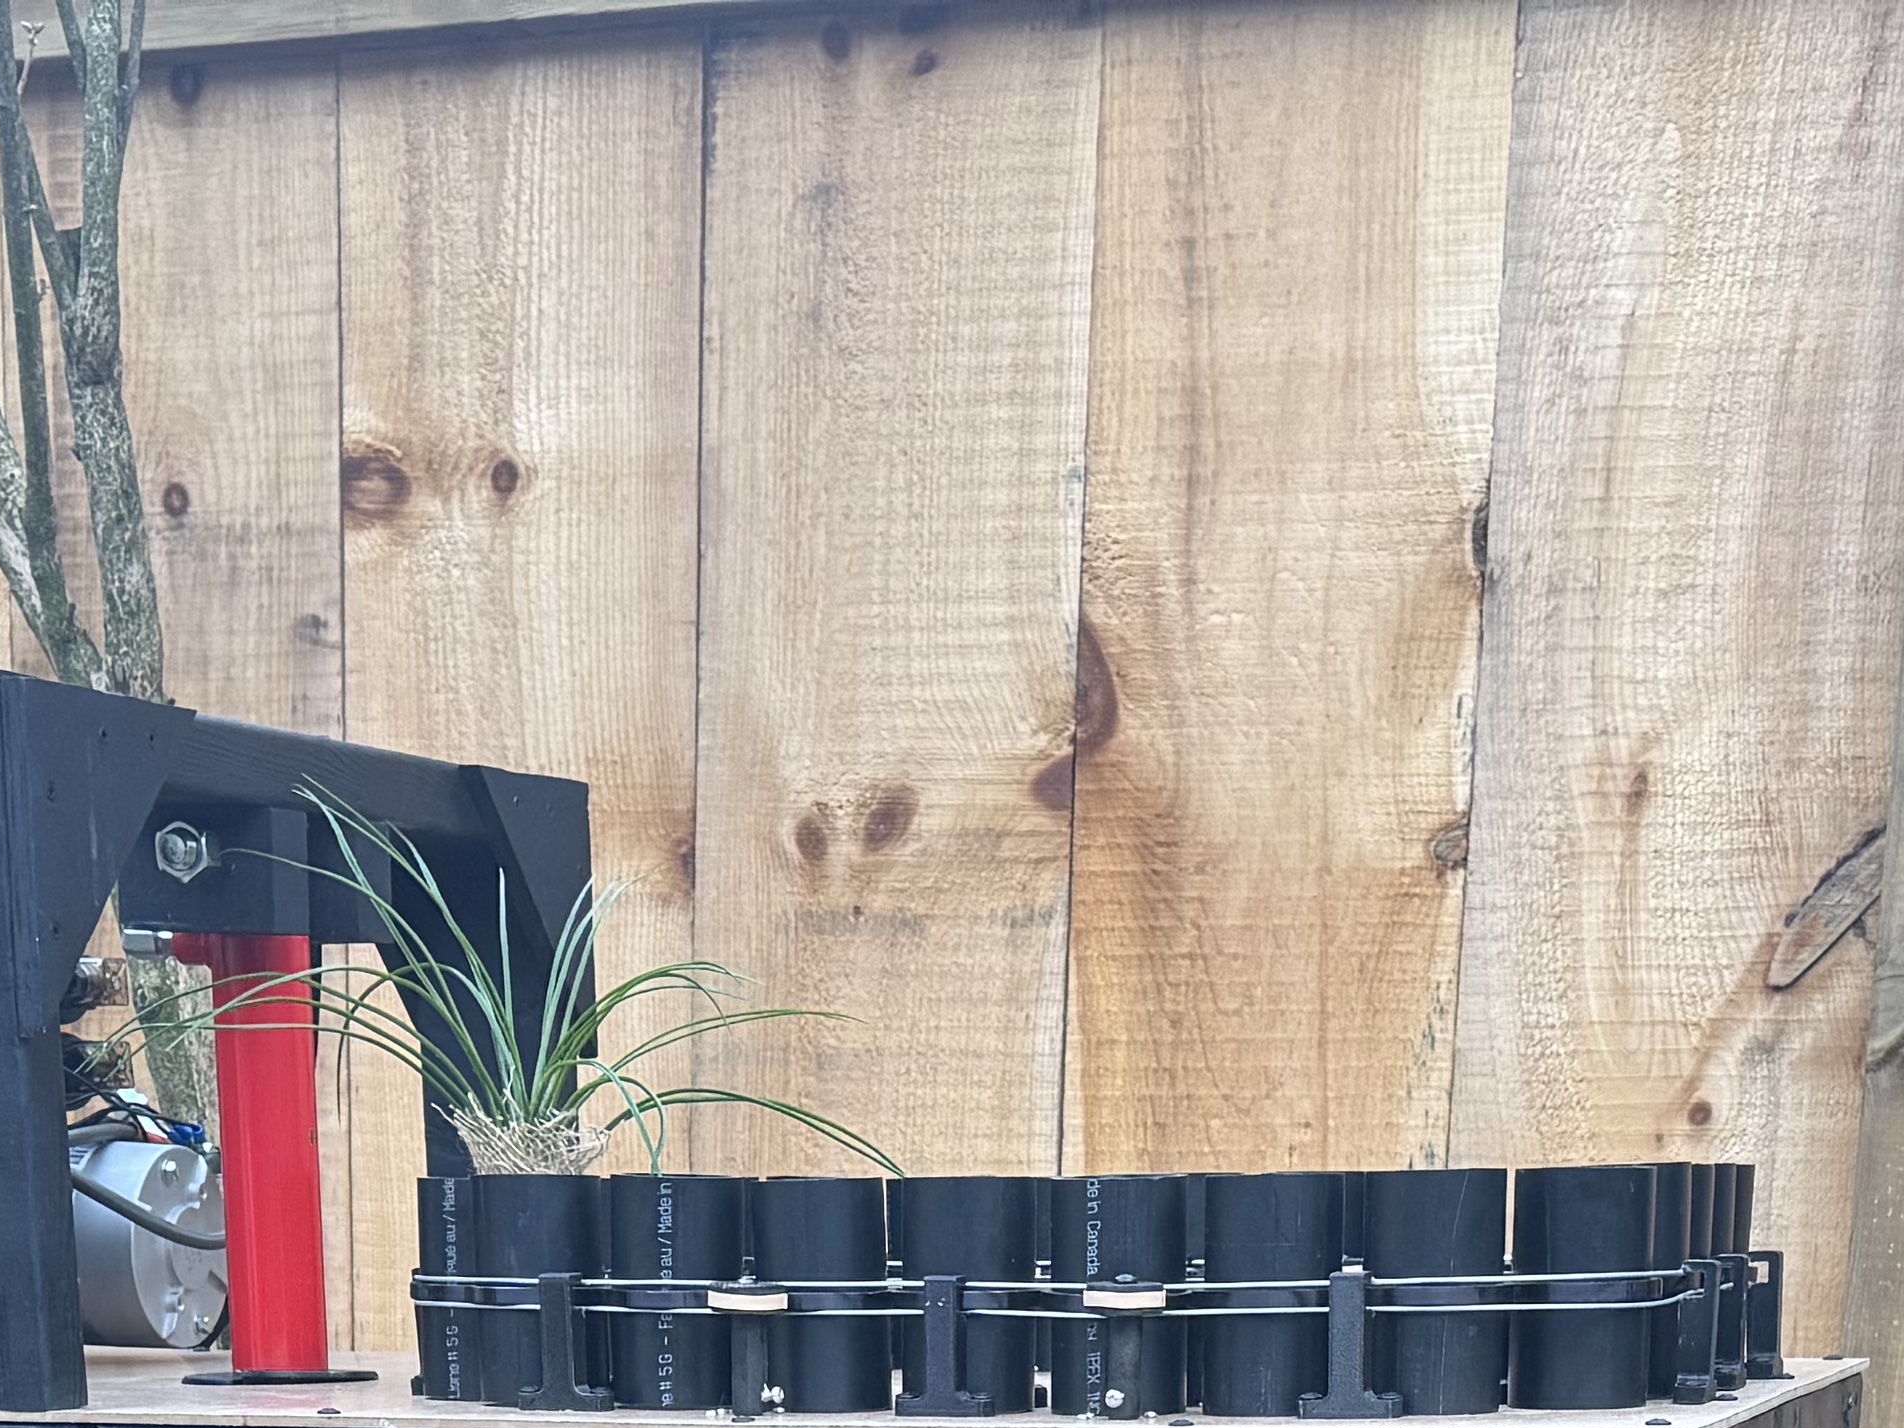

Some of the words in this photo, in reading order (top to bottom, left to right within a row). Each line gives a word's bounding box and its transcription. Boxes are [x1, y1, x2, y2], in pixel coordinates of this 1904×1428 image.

[657, 1182, 672, 1195] in
[657, 1197, 673, 1233] Made
[1087, 1201, 1101, 1214] in
[446, 1224, 456, 1243] au
[660, 1248, 673, 1267] au
[1087, 1220, 1101, 1277] Canada
[658, 1354, 673, 1376] 5G
